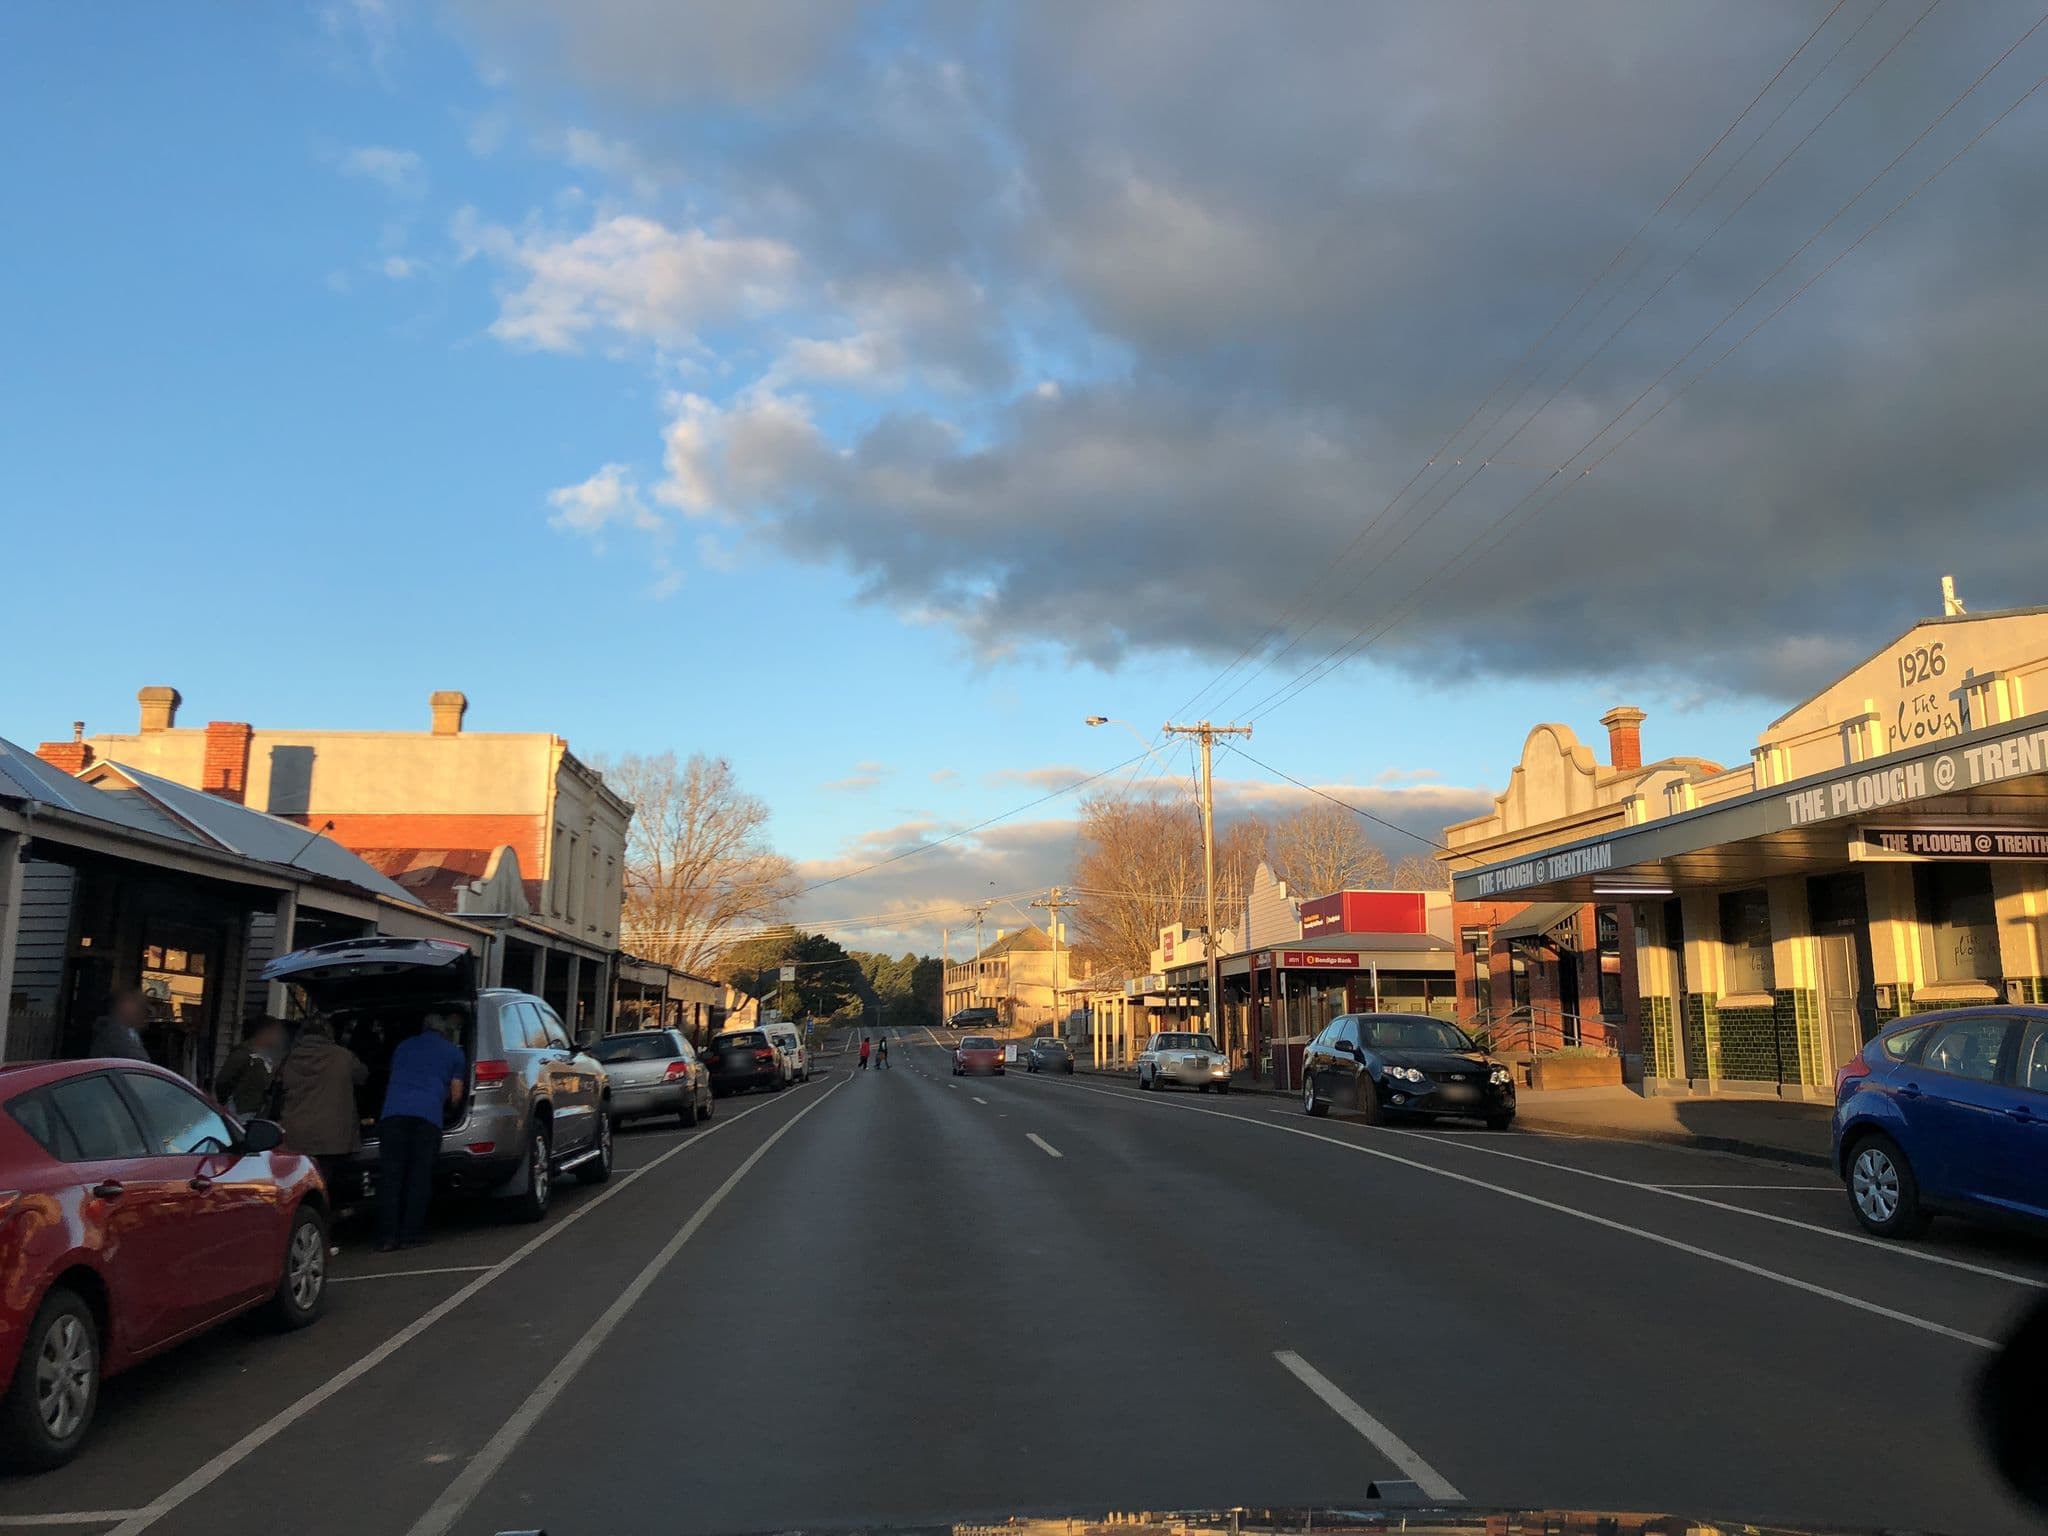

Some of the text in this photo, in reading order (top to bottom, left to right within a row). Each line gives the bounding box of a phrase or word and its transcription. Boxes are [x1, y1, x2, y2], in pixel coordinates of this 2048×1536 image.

[1898, 642, 1946, 689] 1926
[1912, 693, 1938, 715] The
[1786, 788, 1826, 825] THE
[1831, 763, 1926, 816] PLOUGH
[1933, 755, 1956, 791] @
[1880, 834, 1908, 851] THE
[1913, 834, 1971, 852] PLOUGH
[1975, 835, 1992, 853] @
[1478, 843, 1612, 895] THE PLOUGH @ TRENTHAM
